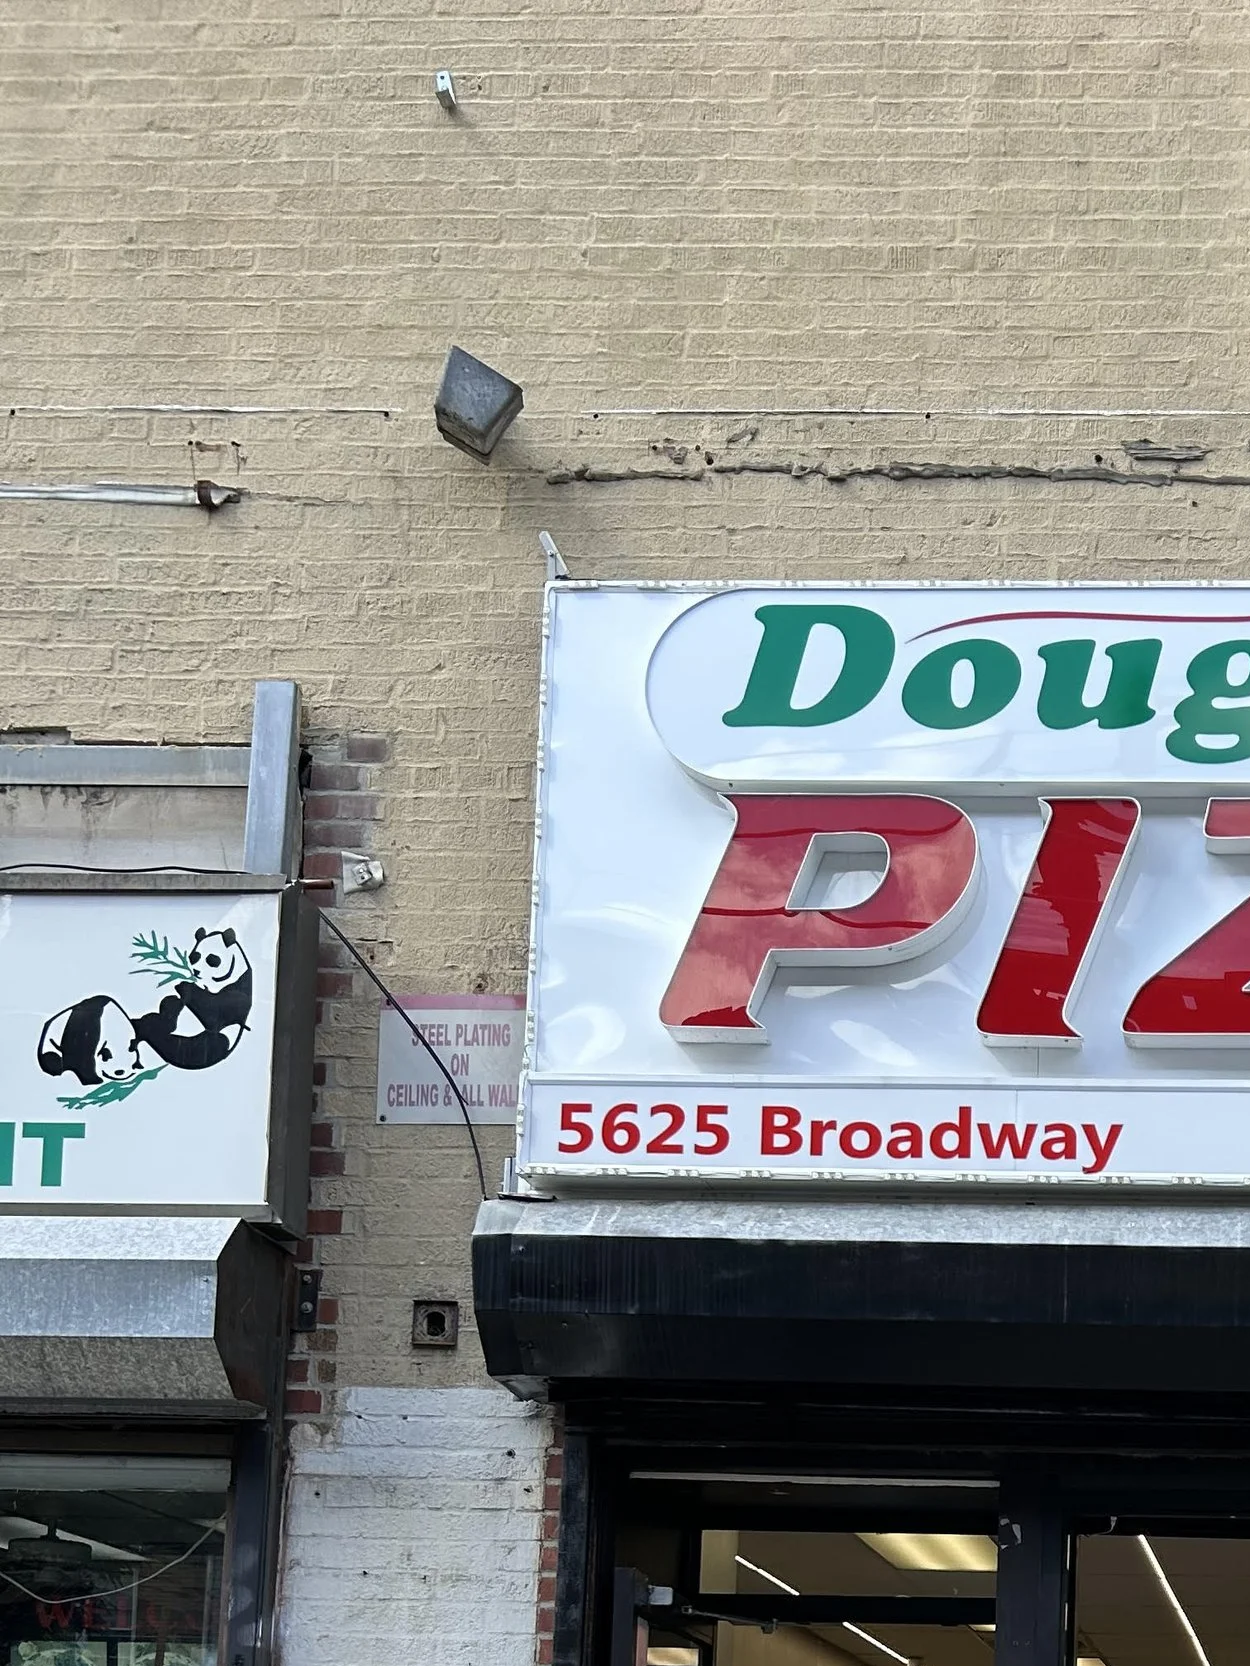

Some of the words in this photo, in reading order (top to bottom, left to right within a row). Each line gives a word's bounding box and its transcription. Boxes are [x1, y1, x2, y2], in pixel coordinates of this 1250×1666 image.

[456, 1023, 511, 1047] PLATING
[451, 1053, 470, 1076] ON
[387, 1083, 439, 1107] CEILING
[443, 1084, 453, 1107] &
[461, 1083, 484, 1107] ALL
[559, 1103, 730, 1155] 5625
[760, 1105, 1122, 1174] Broadway
